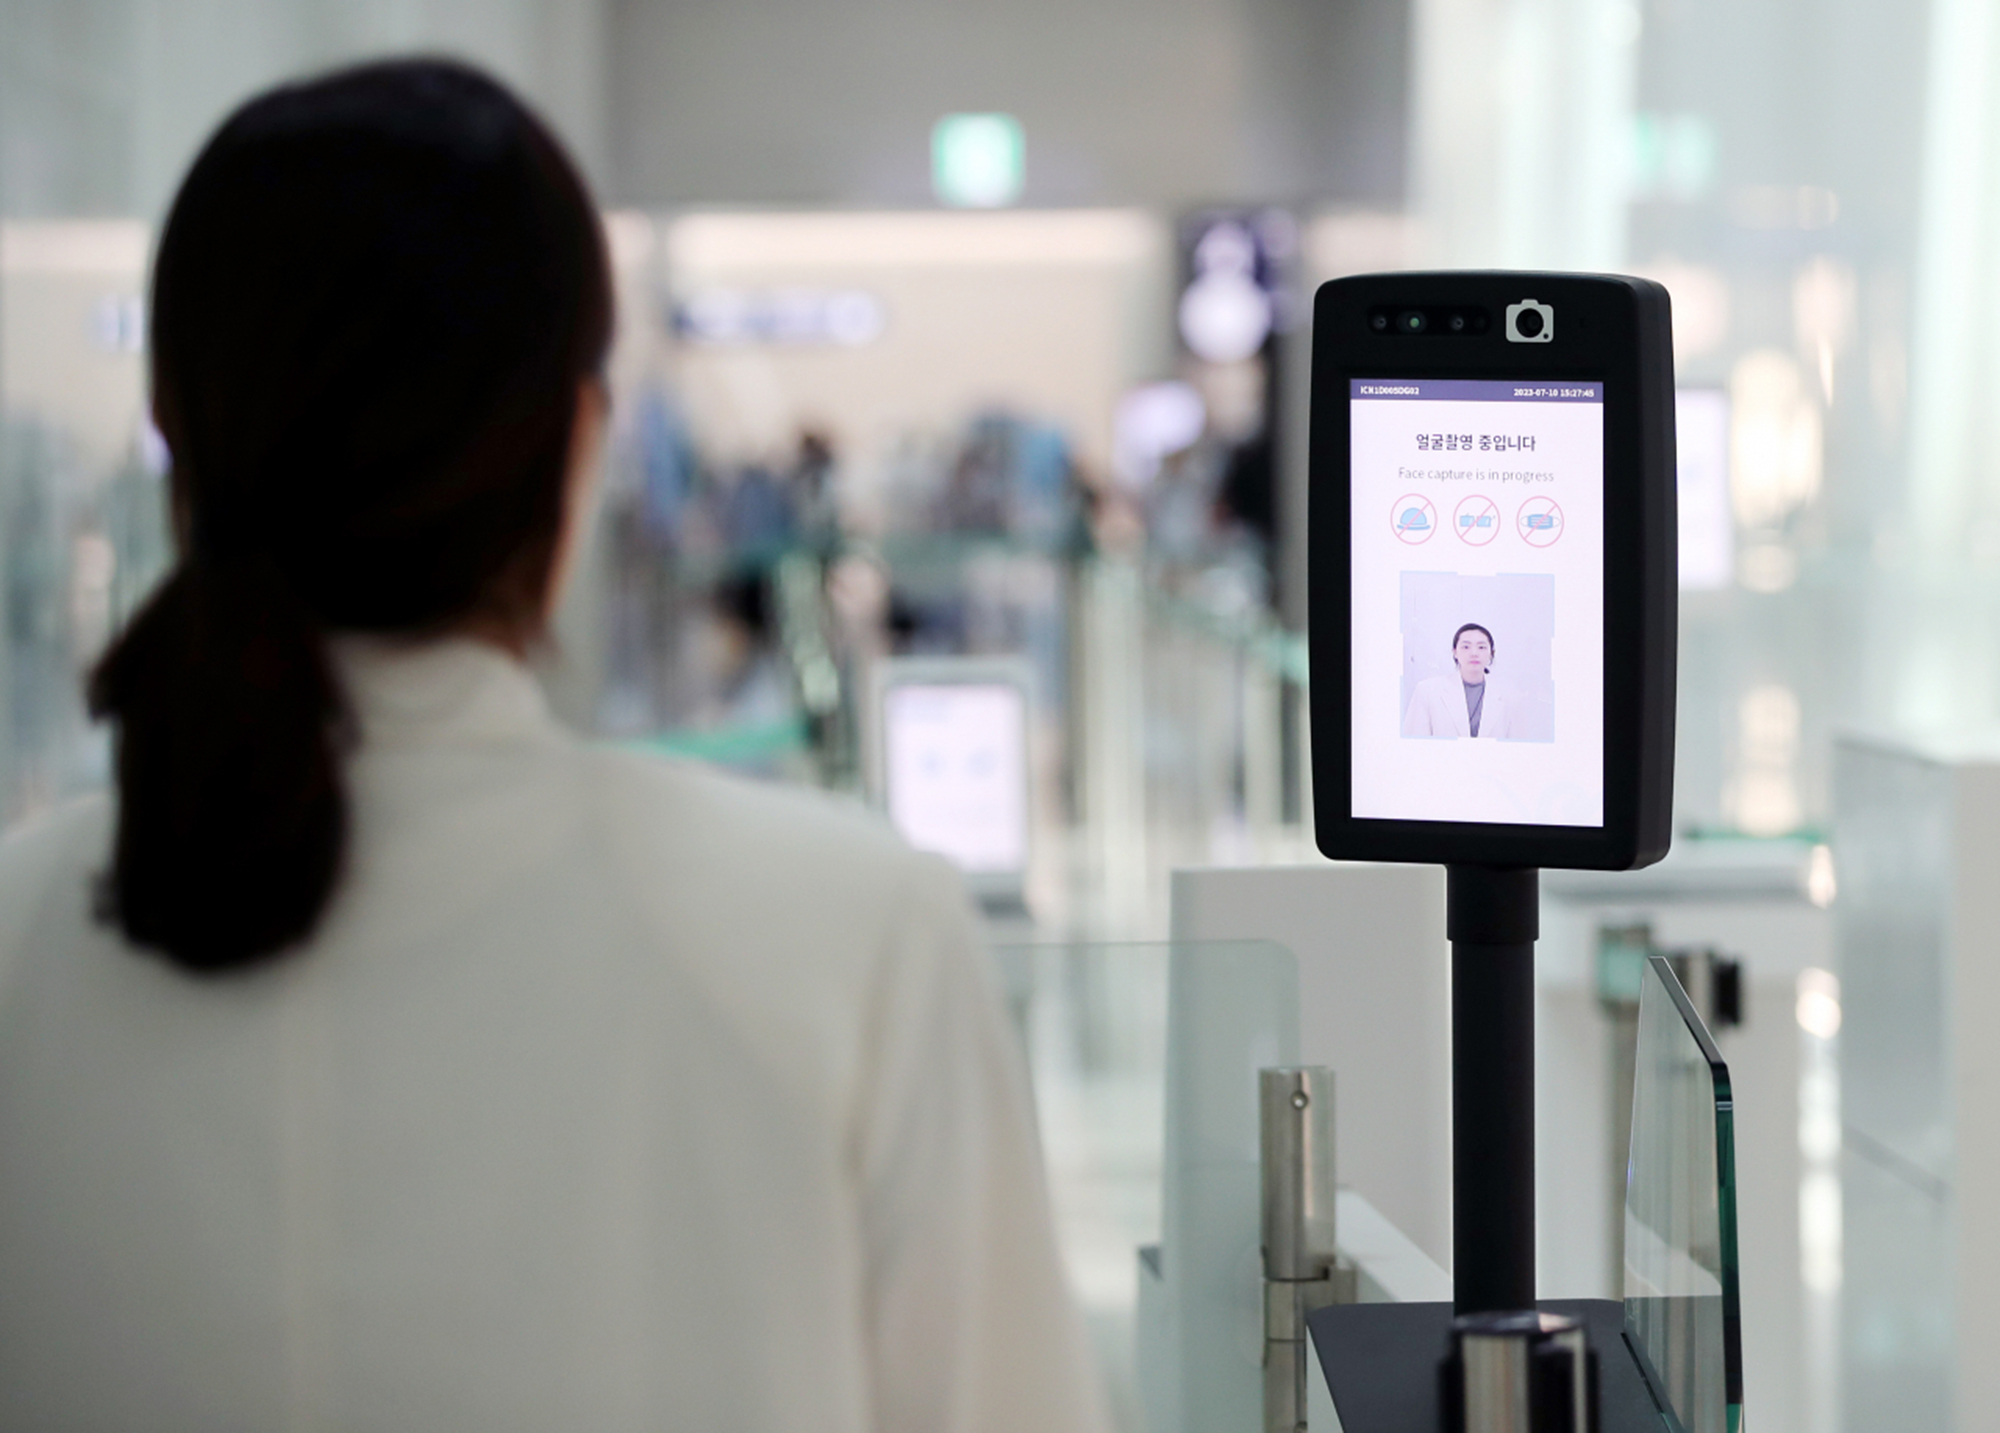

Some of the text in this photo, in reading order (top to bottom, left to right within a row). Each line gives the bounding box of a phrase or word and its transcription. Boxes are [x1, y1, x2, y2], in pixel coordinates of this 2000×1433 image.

[1513, 388, 1595, 397] 2023-07-10 15:27:45
[1416, 433, 1536, 452] 얼굴촬영 중입니다
[1398, 467, 1555, 485] Face capture is in progress
